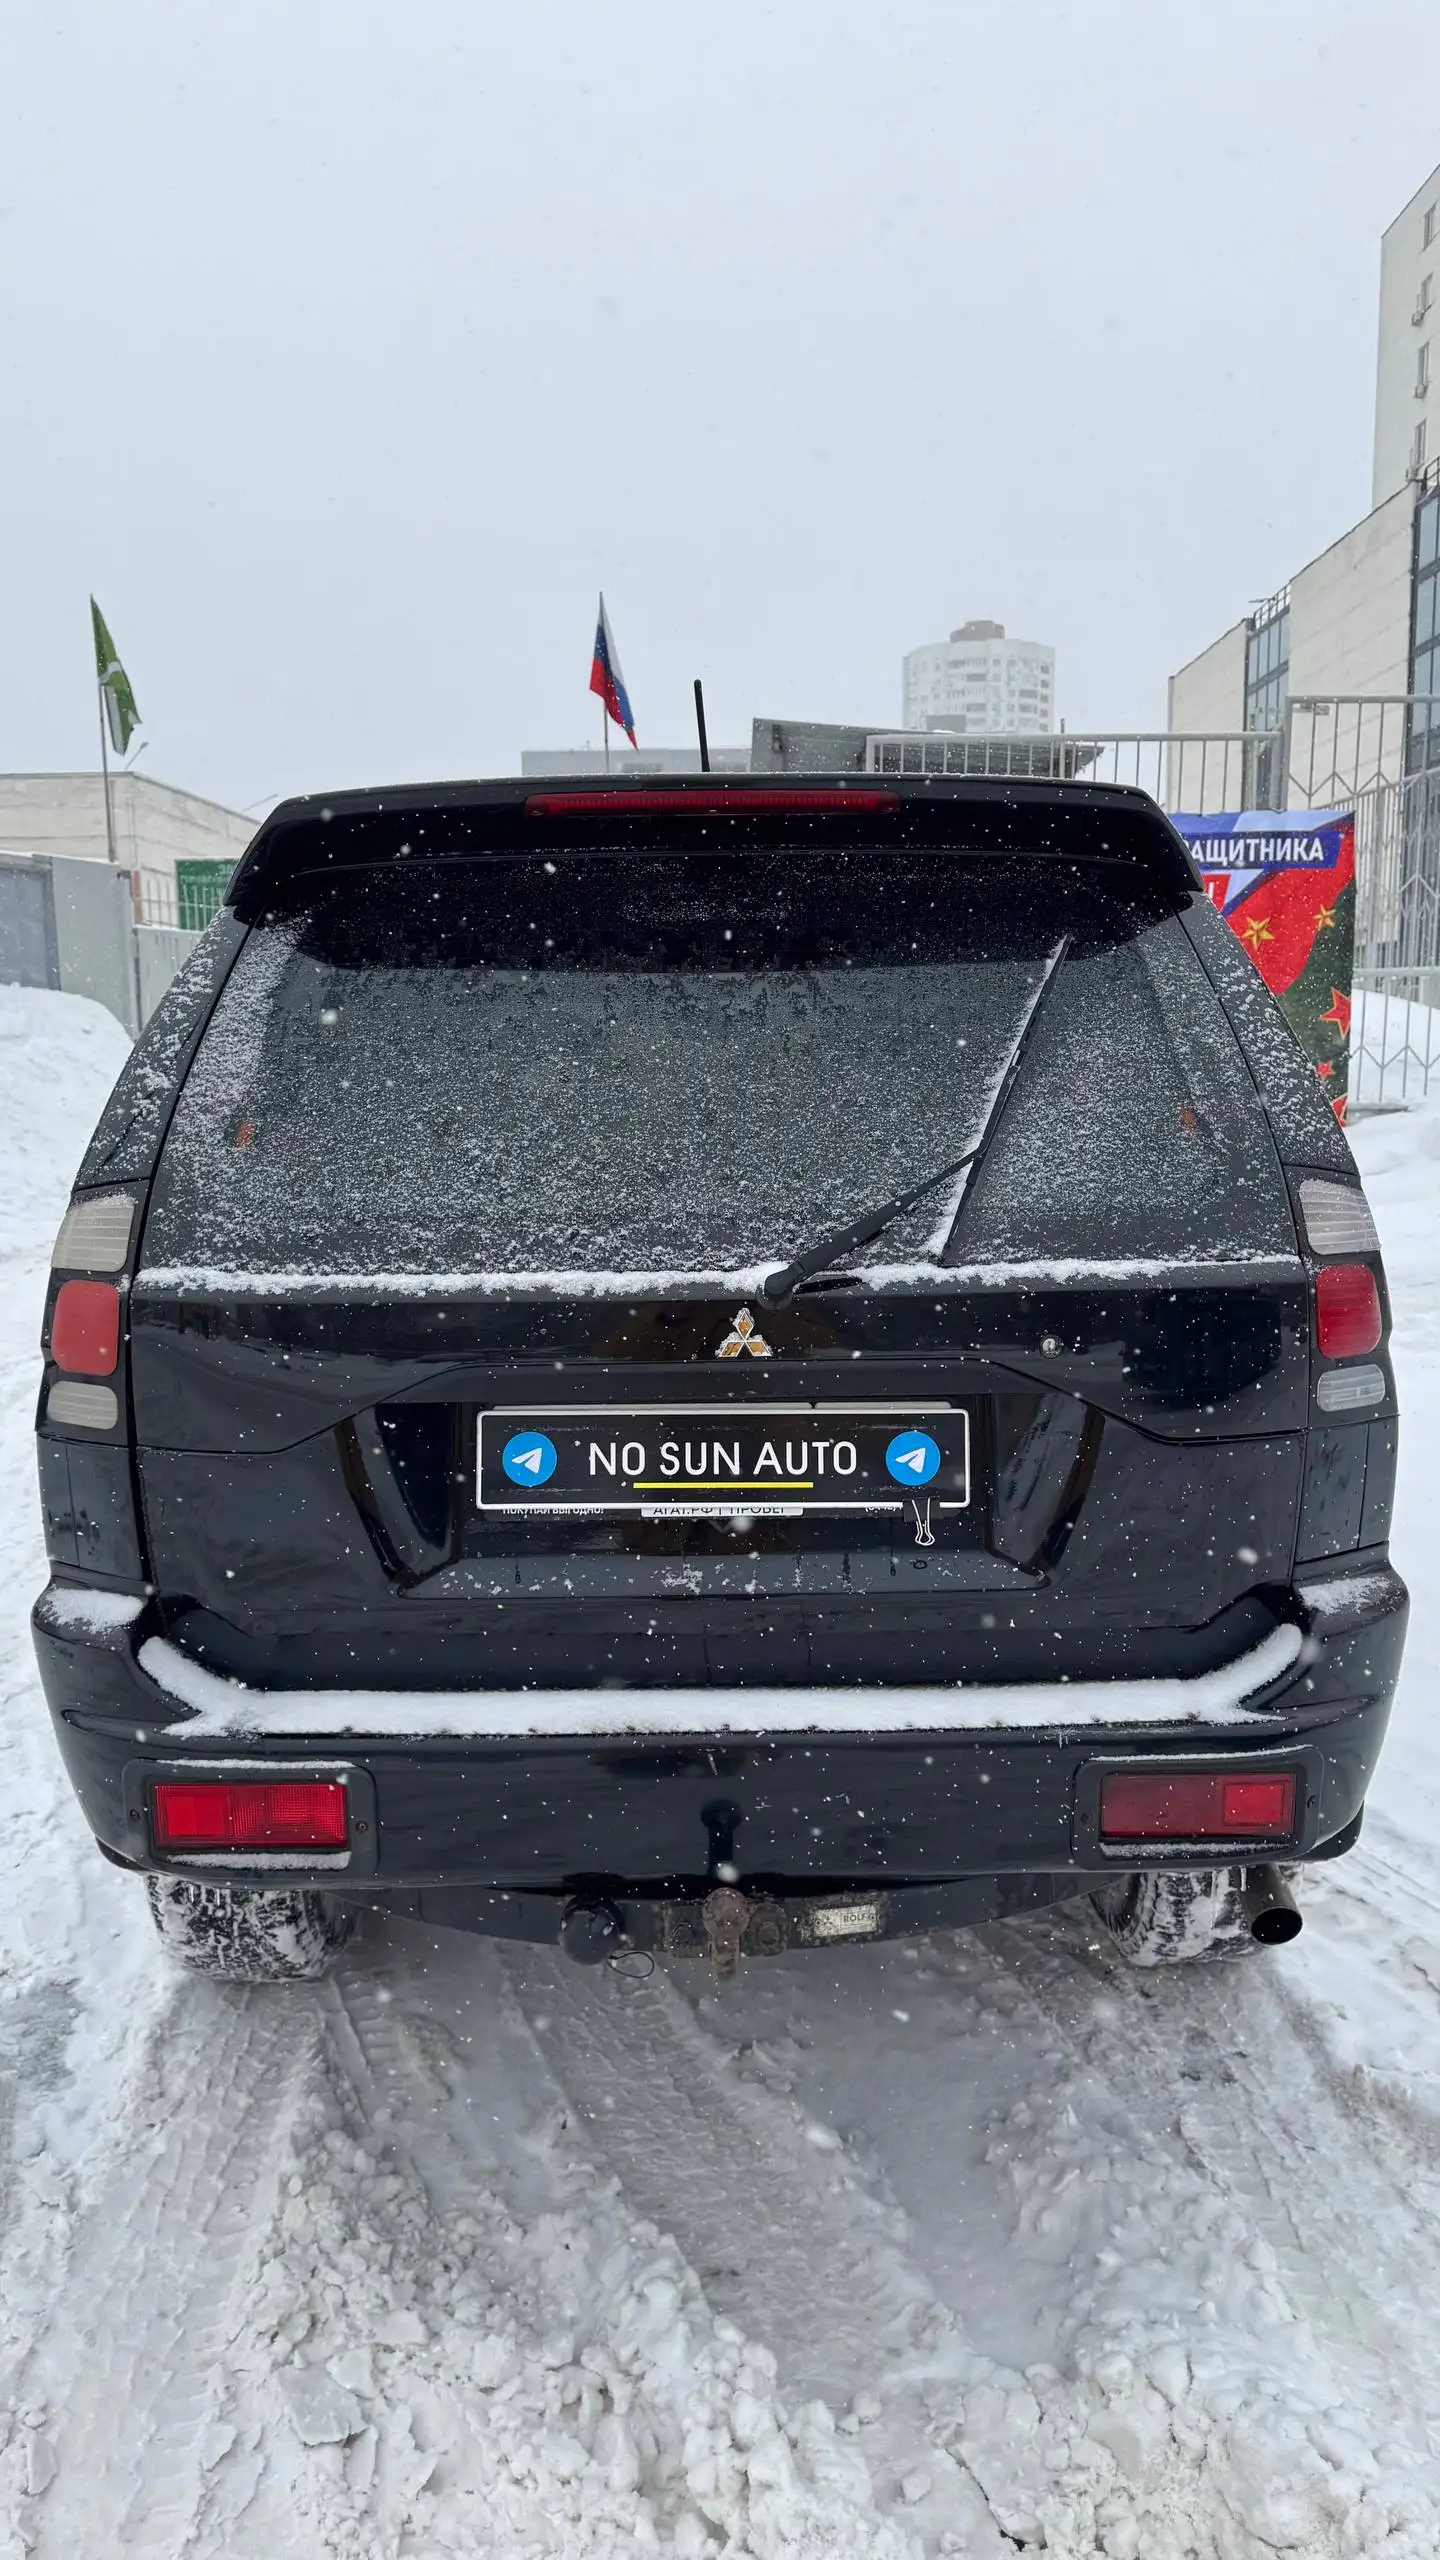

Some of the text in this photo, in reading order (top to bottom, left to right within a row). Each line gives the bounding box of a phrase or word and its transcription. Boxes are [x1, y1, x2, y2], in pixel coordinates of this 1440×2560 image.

[1186, 837, 1325, 867] АЩИТНИКА
[589, 1440, 858, 1476] NO SUN AUTO
